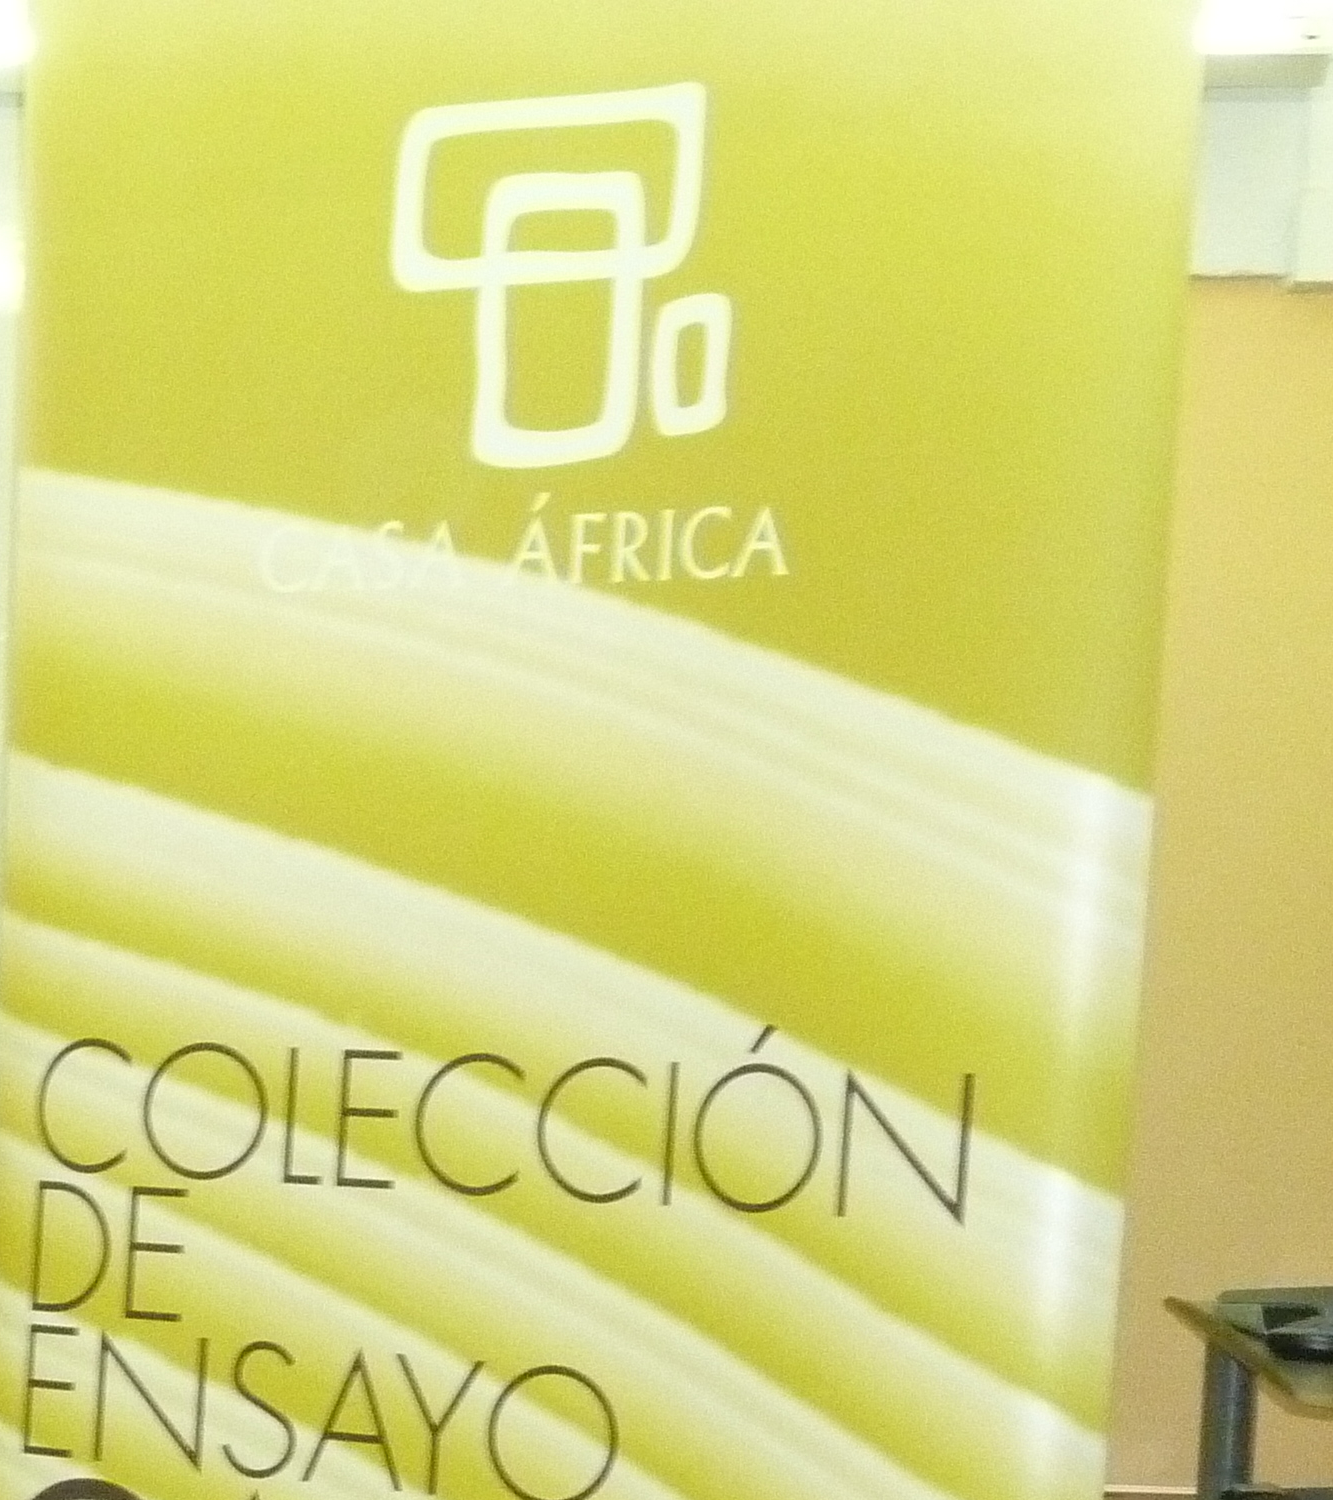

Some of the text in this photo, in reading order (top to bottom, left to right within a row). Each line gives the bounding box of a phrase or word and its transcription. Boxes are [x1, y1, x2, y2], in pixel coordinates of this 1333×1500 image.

[259, 491, 790, 594] CASA ÁFRICA
[36, 1024, 977, 1228] COLECCIÓN
[29, 1180, 191, 1322] DE
